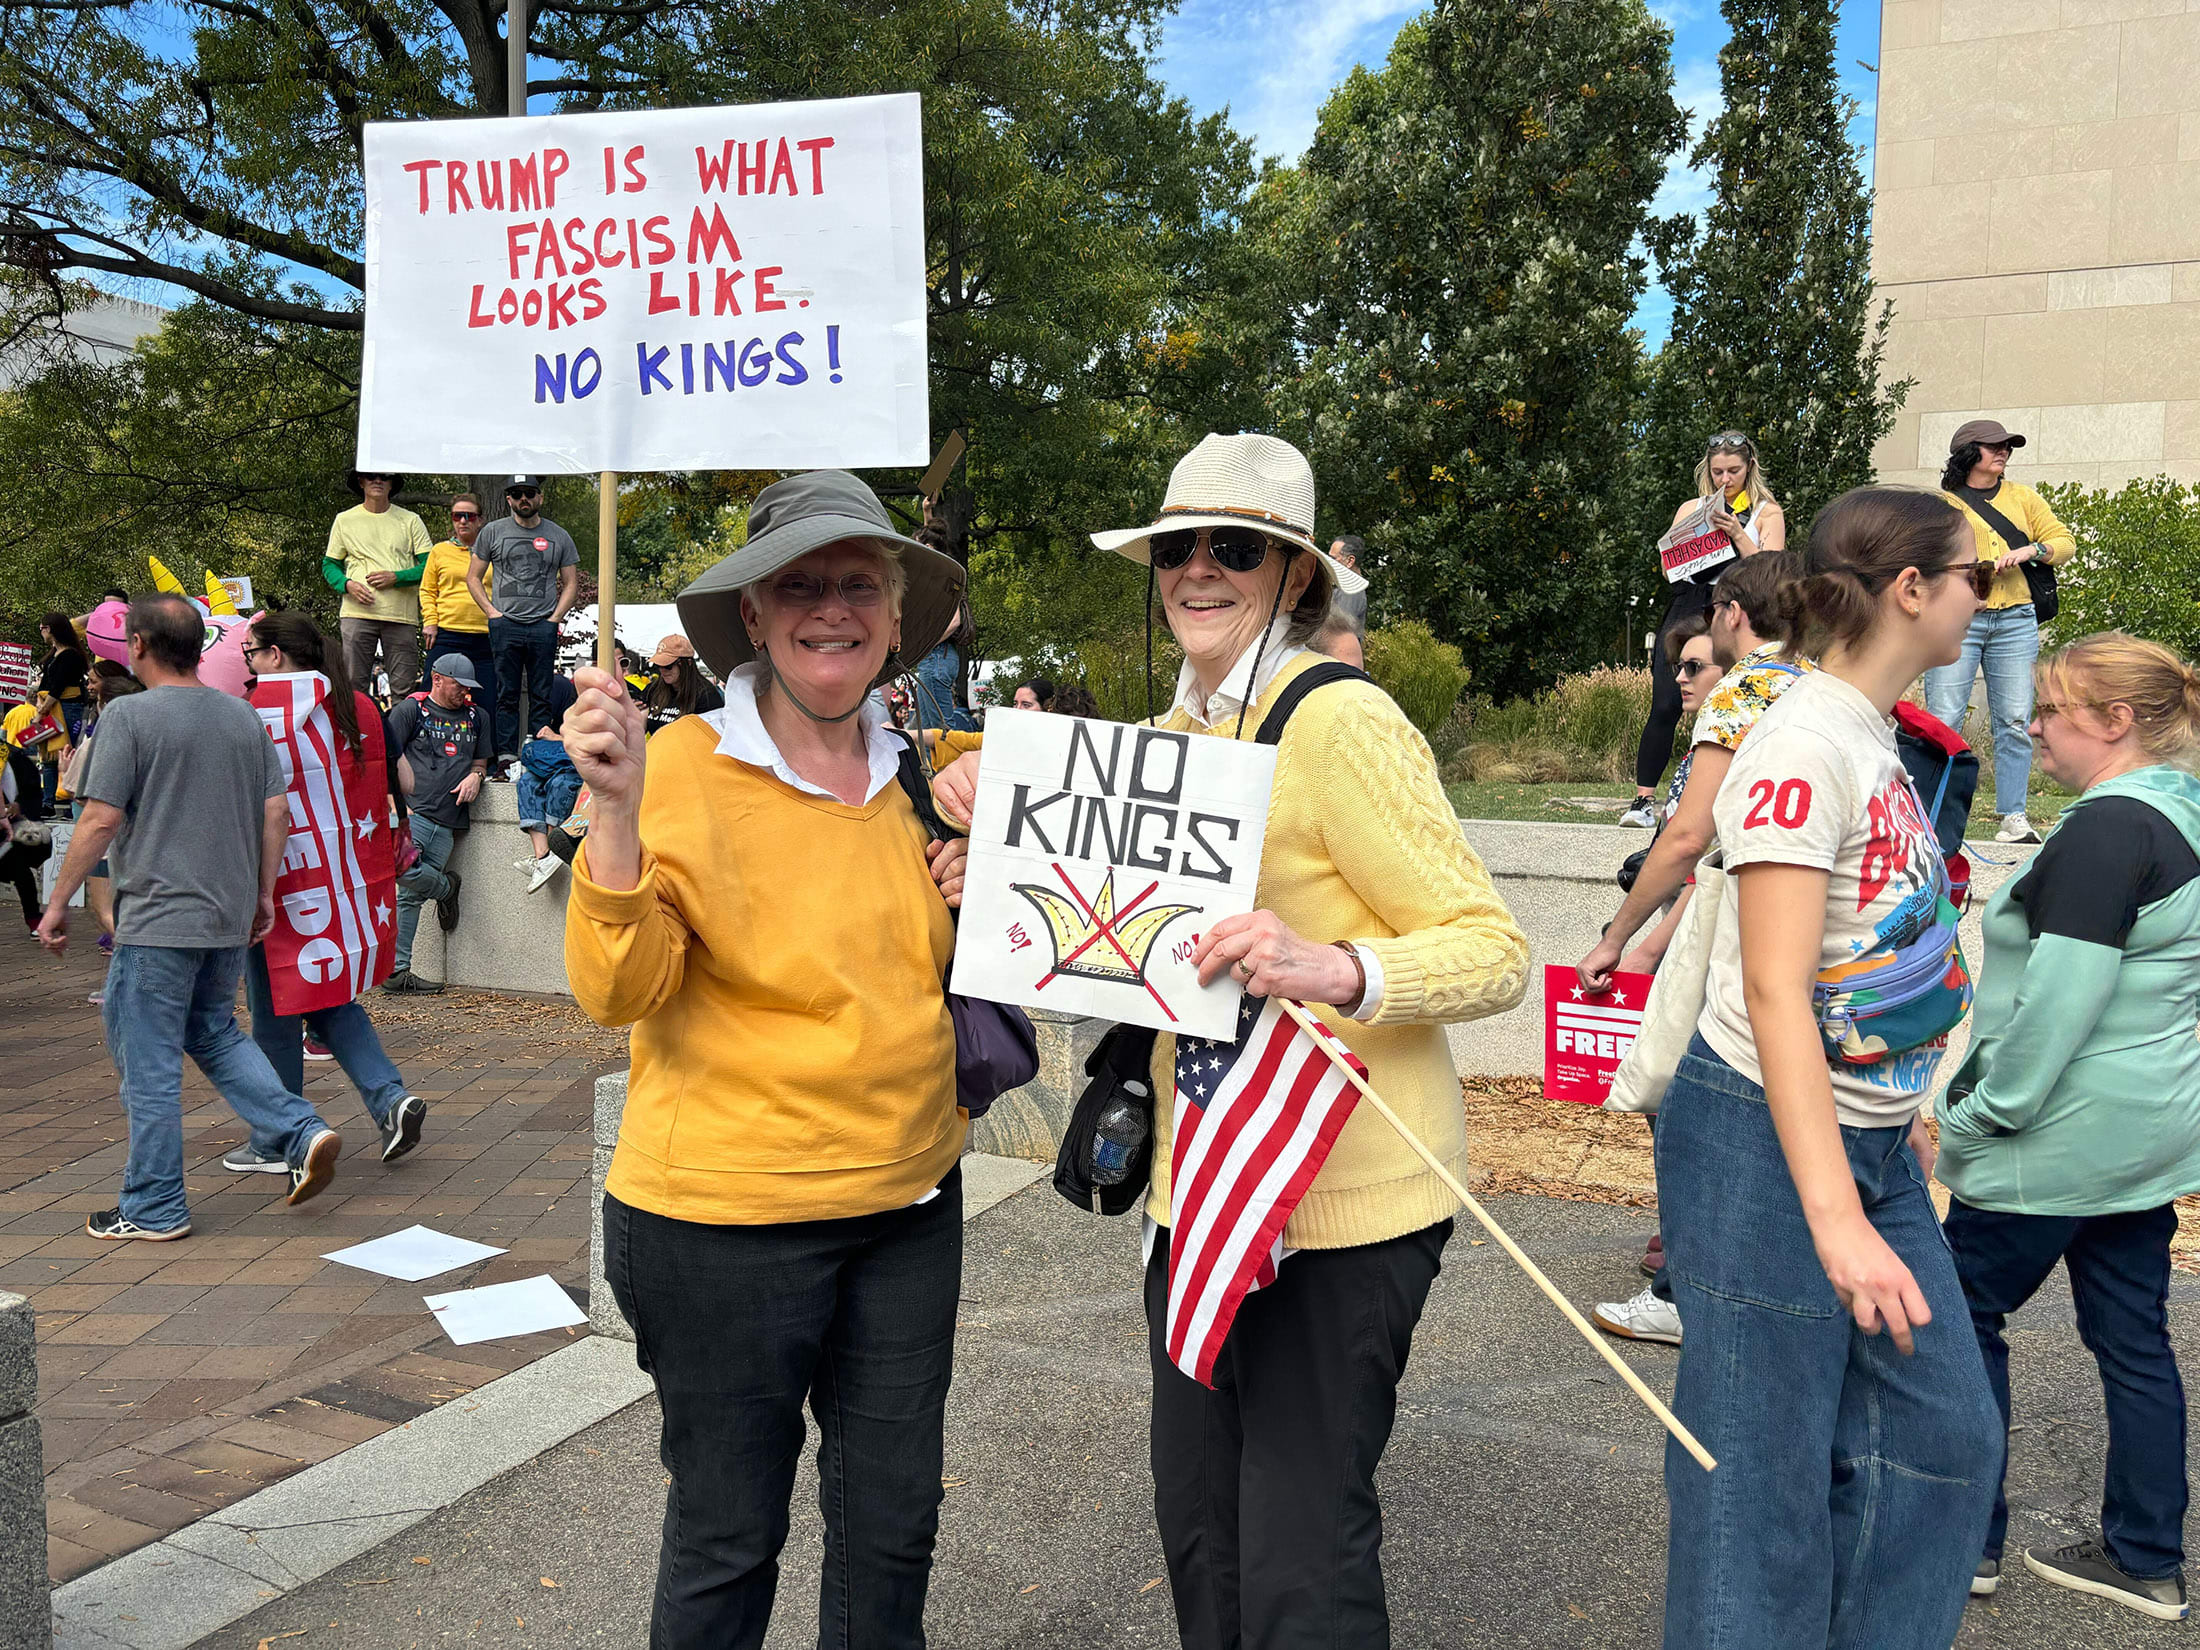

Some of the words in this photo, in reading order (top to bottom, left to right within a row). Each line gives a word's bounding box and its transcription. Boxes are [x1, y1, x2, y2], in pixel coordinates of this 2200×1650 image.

[403, 148, 570, 215] TRUMP
[604, 145, 648, 196] IS
[695, 136, 836, 197] WHAT
[507, 202, 743, 280] FASCISM
[468, 277, 608, 331] LOOKS
[648, 265, 811, 317] LIKE.
[534, 346, 602, 404] NO
[1662, 544, 1690, 568] HELL
[1688, 540, 1704, 557] AS
[1703, 530, 1730, 552] MAD
[0, 685, 18, 699] NG
[1063, 718, 1190, 805] NO
[1743, 778, 1812, 830] 20
[1004, 783, 1241, 884] KINGS
[281, 884, 345, 985] DC
[1005, 921, 1033, 953] NO!
